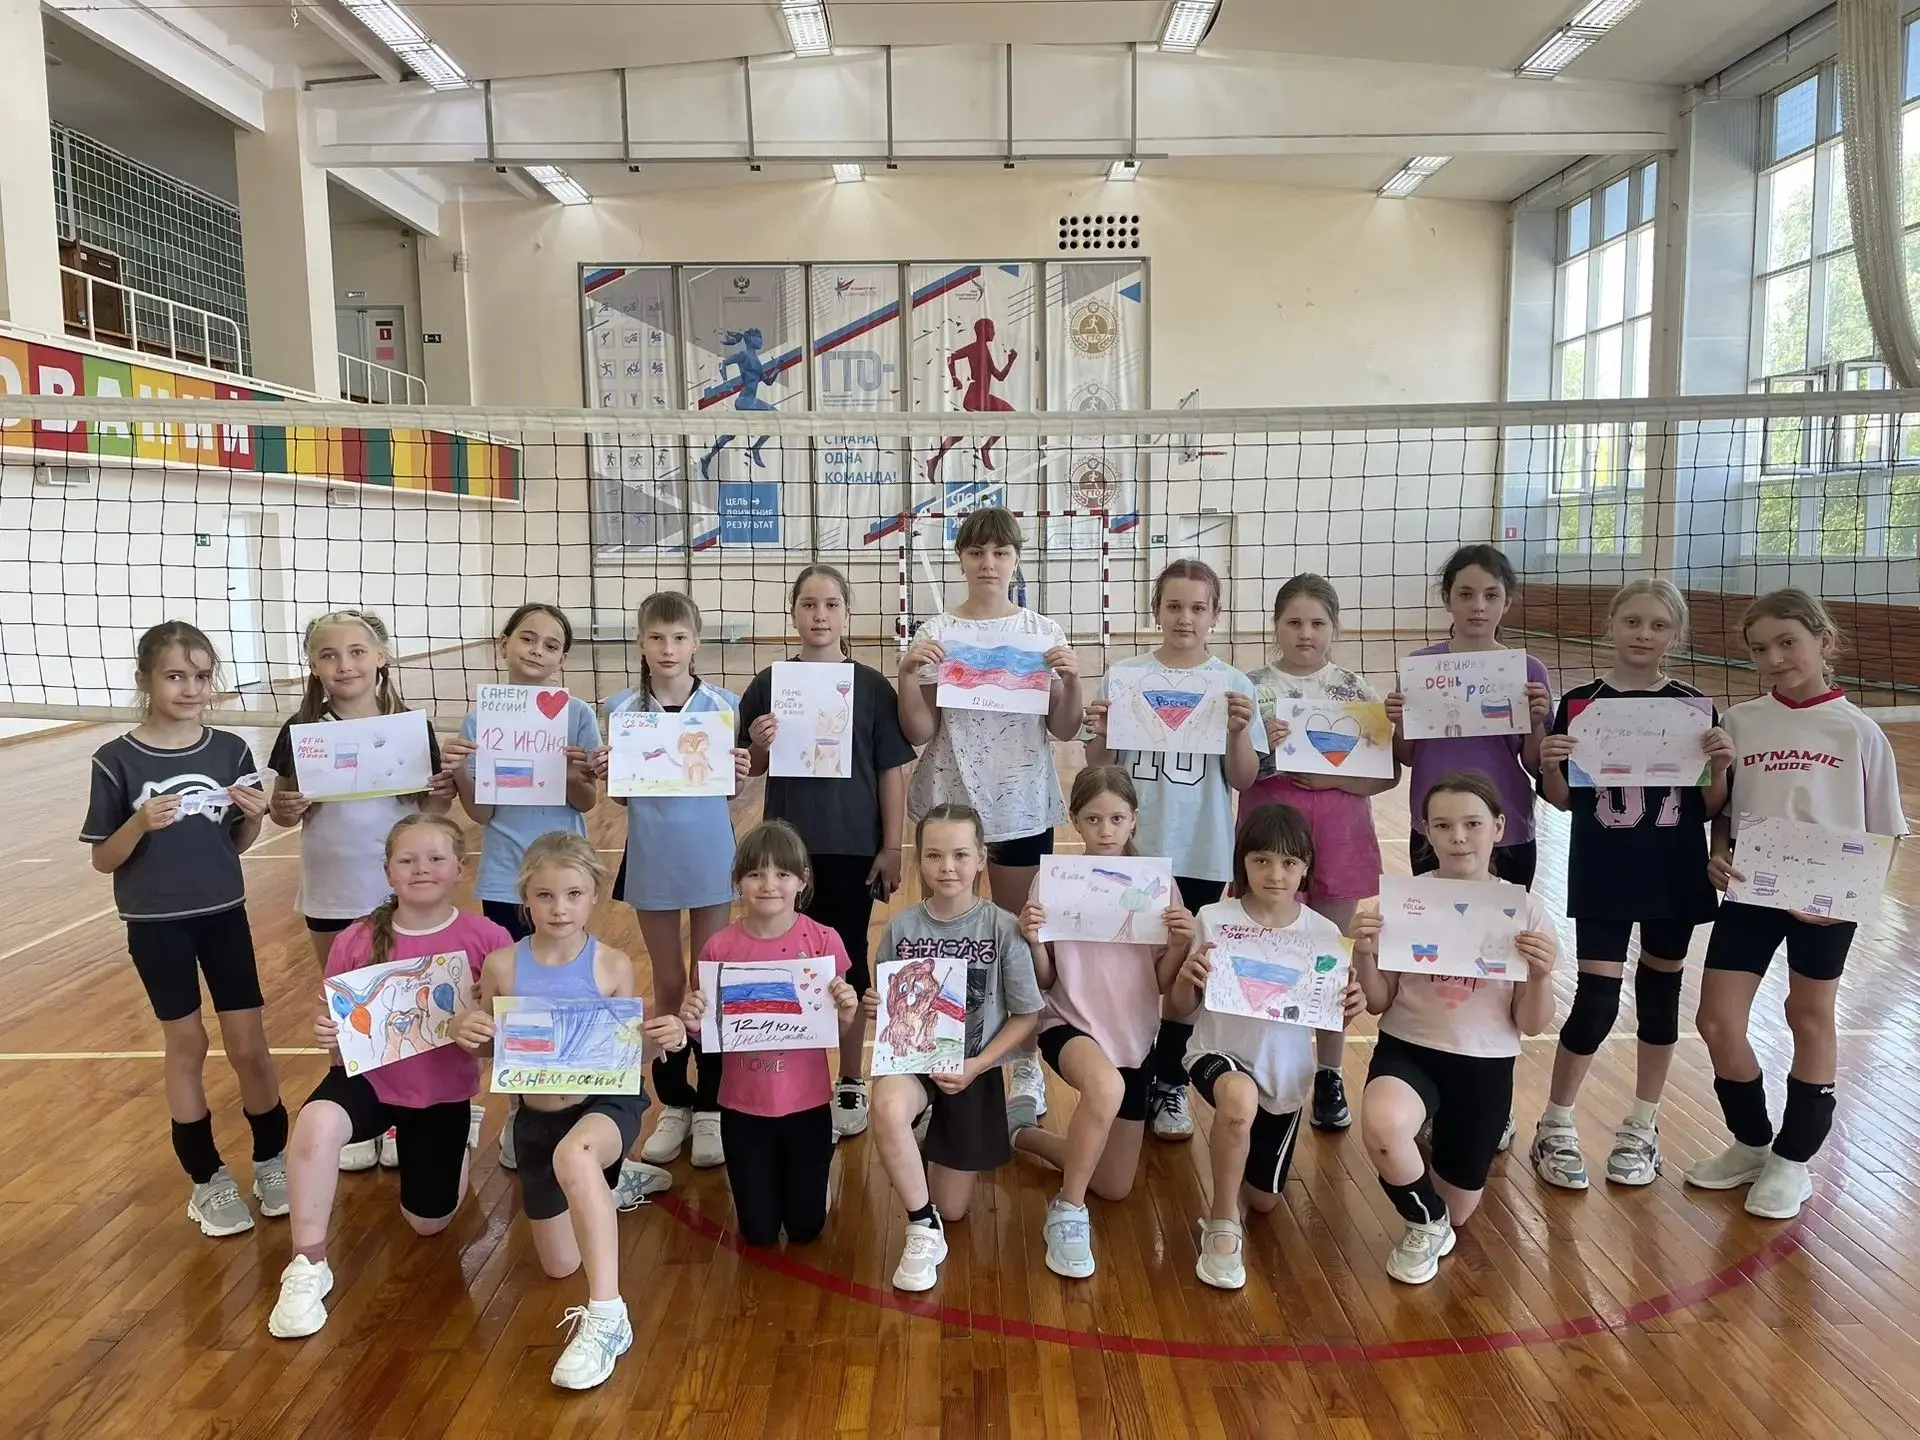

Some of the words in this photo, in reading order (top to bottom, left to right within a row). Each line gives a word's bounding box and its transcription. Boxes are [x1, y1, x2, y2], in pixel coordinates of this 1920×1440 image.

[824, 452, 863, 464] ОДНА
[824, 471, 897, 484] КОМАНДА!
[725, 497, 748, 506] ЦЕЛЬ
[726, 520, 774, 529] РЕЗУЛЬТАТ
[482, 727, 504, 751] 12
[1743, 750, 1844, 768] DYNAMIC
[1764, 763, 1812, 772] MODE
[730, 1019, 757, 1033] 12
[739, 1058, 786, 1073] LOVE
